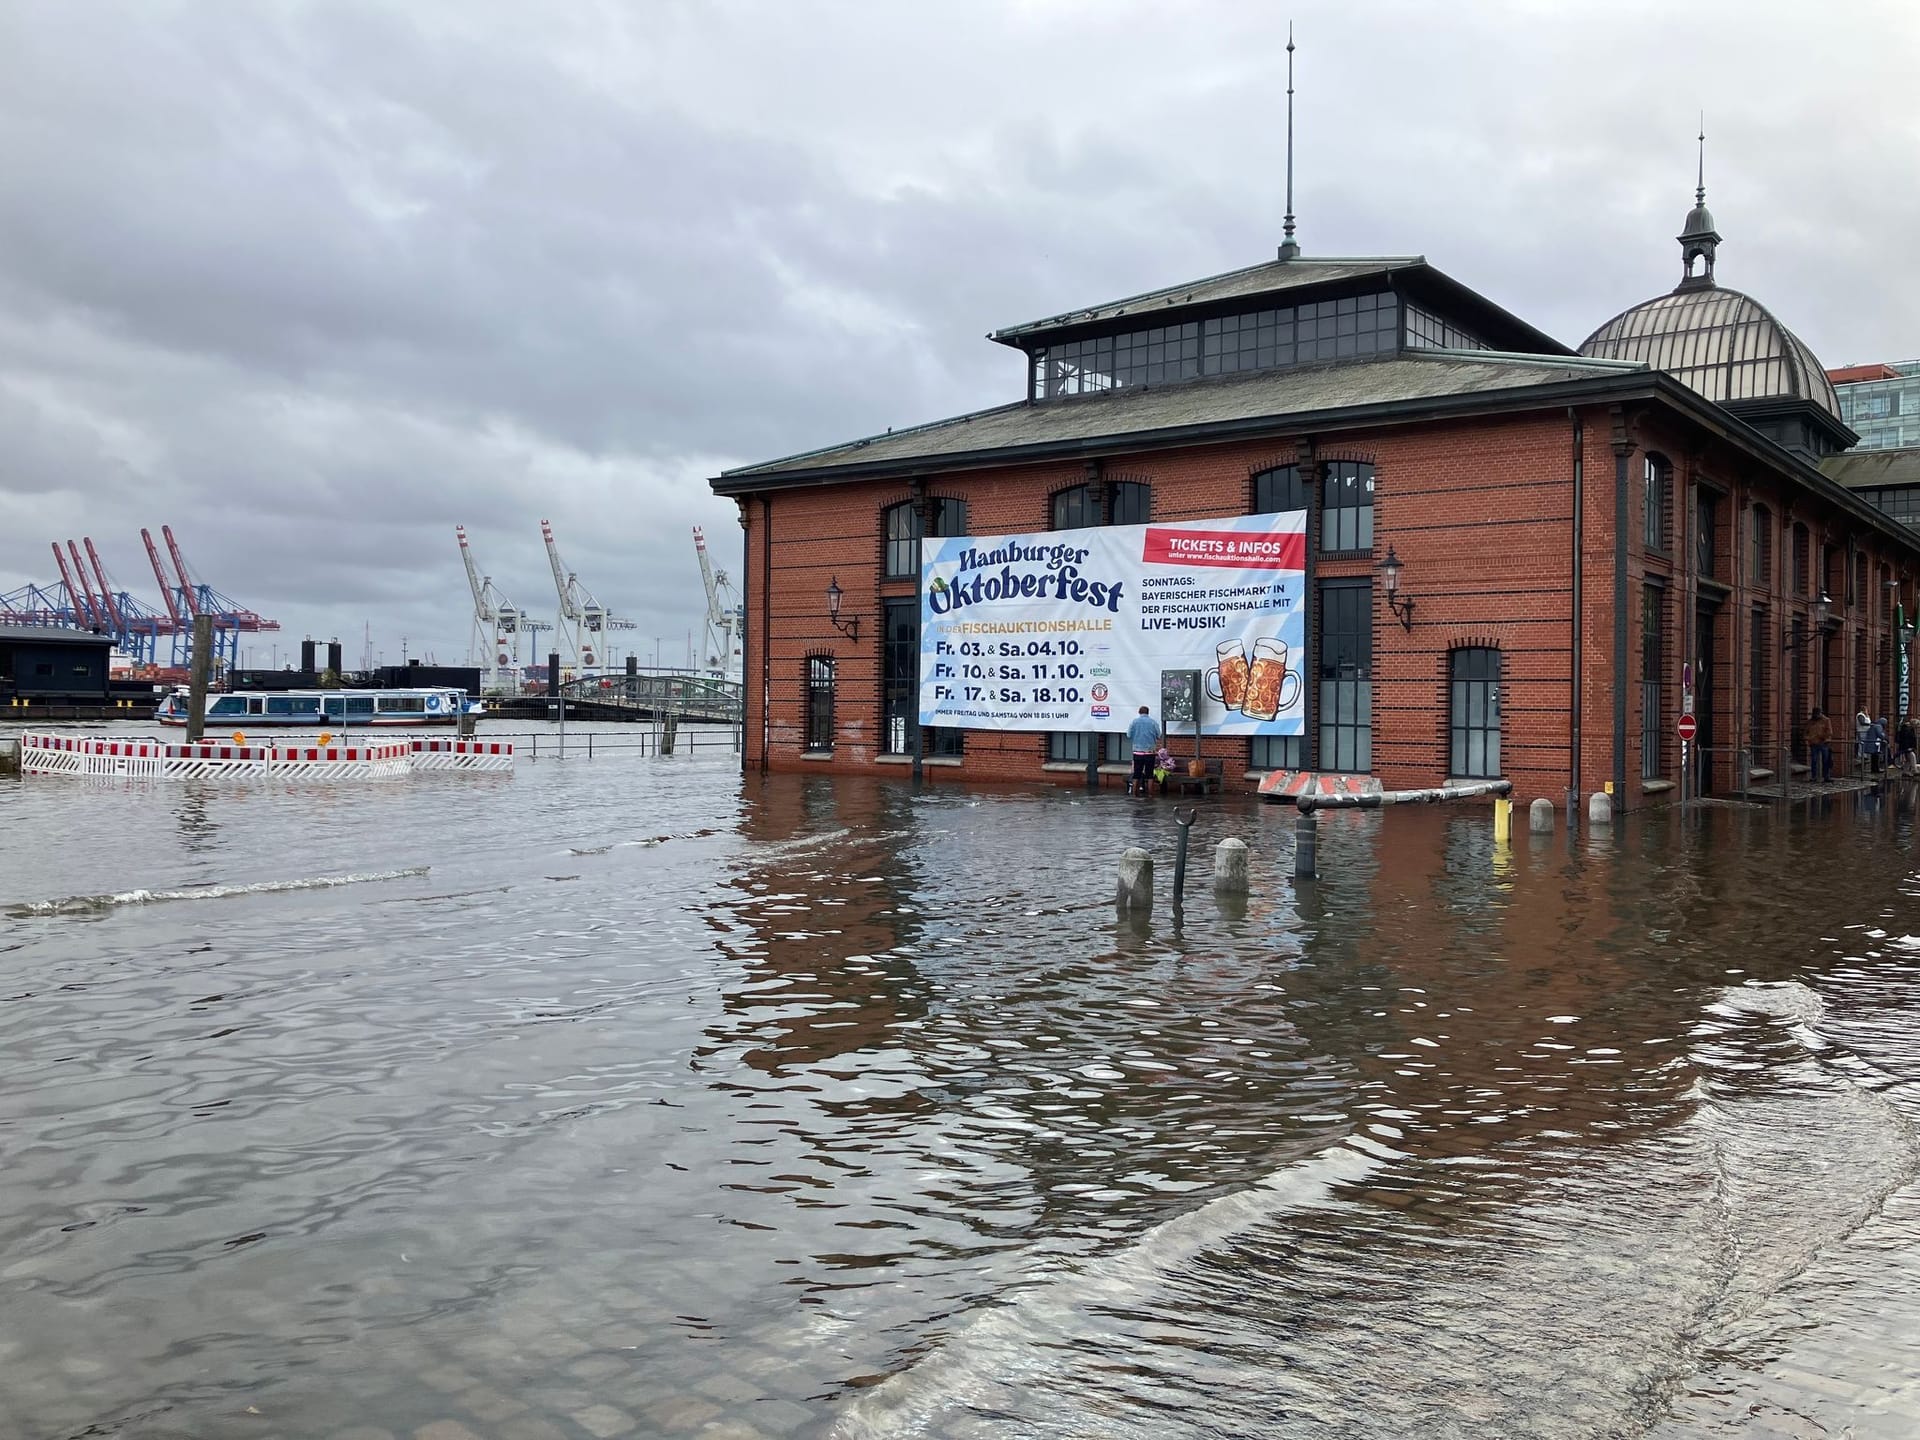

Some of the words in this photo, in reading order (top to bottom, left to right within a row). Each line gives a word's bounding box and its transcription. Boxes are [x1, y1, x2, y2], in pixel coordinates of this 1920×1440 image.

[1170, 539, 1223, 552] TICKETS
[1227, 542, 1235, 552] &
[1239, 542, 1281, 554] INFOS
[959, 541, 1089, 572] Hamburger
[1187, 553, 1281, 563] www.fischauktionshalle.com
[929, 565, 1124, 614] Oktoberfest
[1142, 577, 1195, 587] SONNTAGS:
[1142, 589, 1206, 600] BAYERISCHER
[1209, 586, 1271, 598] FISCHMARKT
[1273, 584, 1284, 593] IN
[1142, 605, 1159, 613] DER
[1163, 600, 1269, 613] FISCHAUKTIONSHALLE
[1272, 598, 1291, 607] MIT
[962, 619, 1112, 634] FISCHAUKTIONSHALLE
[1141, 616, 1226, 629] LIVE-MUSIK!
[936, 641, 955, 655] Fr.
[960, 642, 985, 656] 03.
[987, 644, 995, 654] &
[999, 643, 1025, 656] Sa.
[1027, 640, 1084, 656] 04.10.
[935, 663, 955, 677] Fr.
[962, 664, 985, 679] 10.
[988, 667, 995, 677] &
[999, 665, 1025, 679] Sa.
[1899, 643, 1909, 716] RDINGER
[935, 685, 954, 699] Fr.
[964, 687, 985, 701] 17.
[989, 690, 996, 700] &
[1000, 688, 1026, 702] Sa.
[1032, 688, 1084, 702] 18.10.
[954, 709, 977, 717] FREITAG
[977, 710, 989, 718] UND
